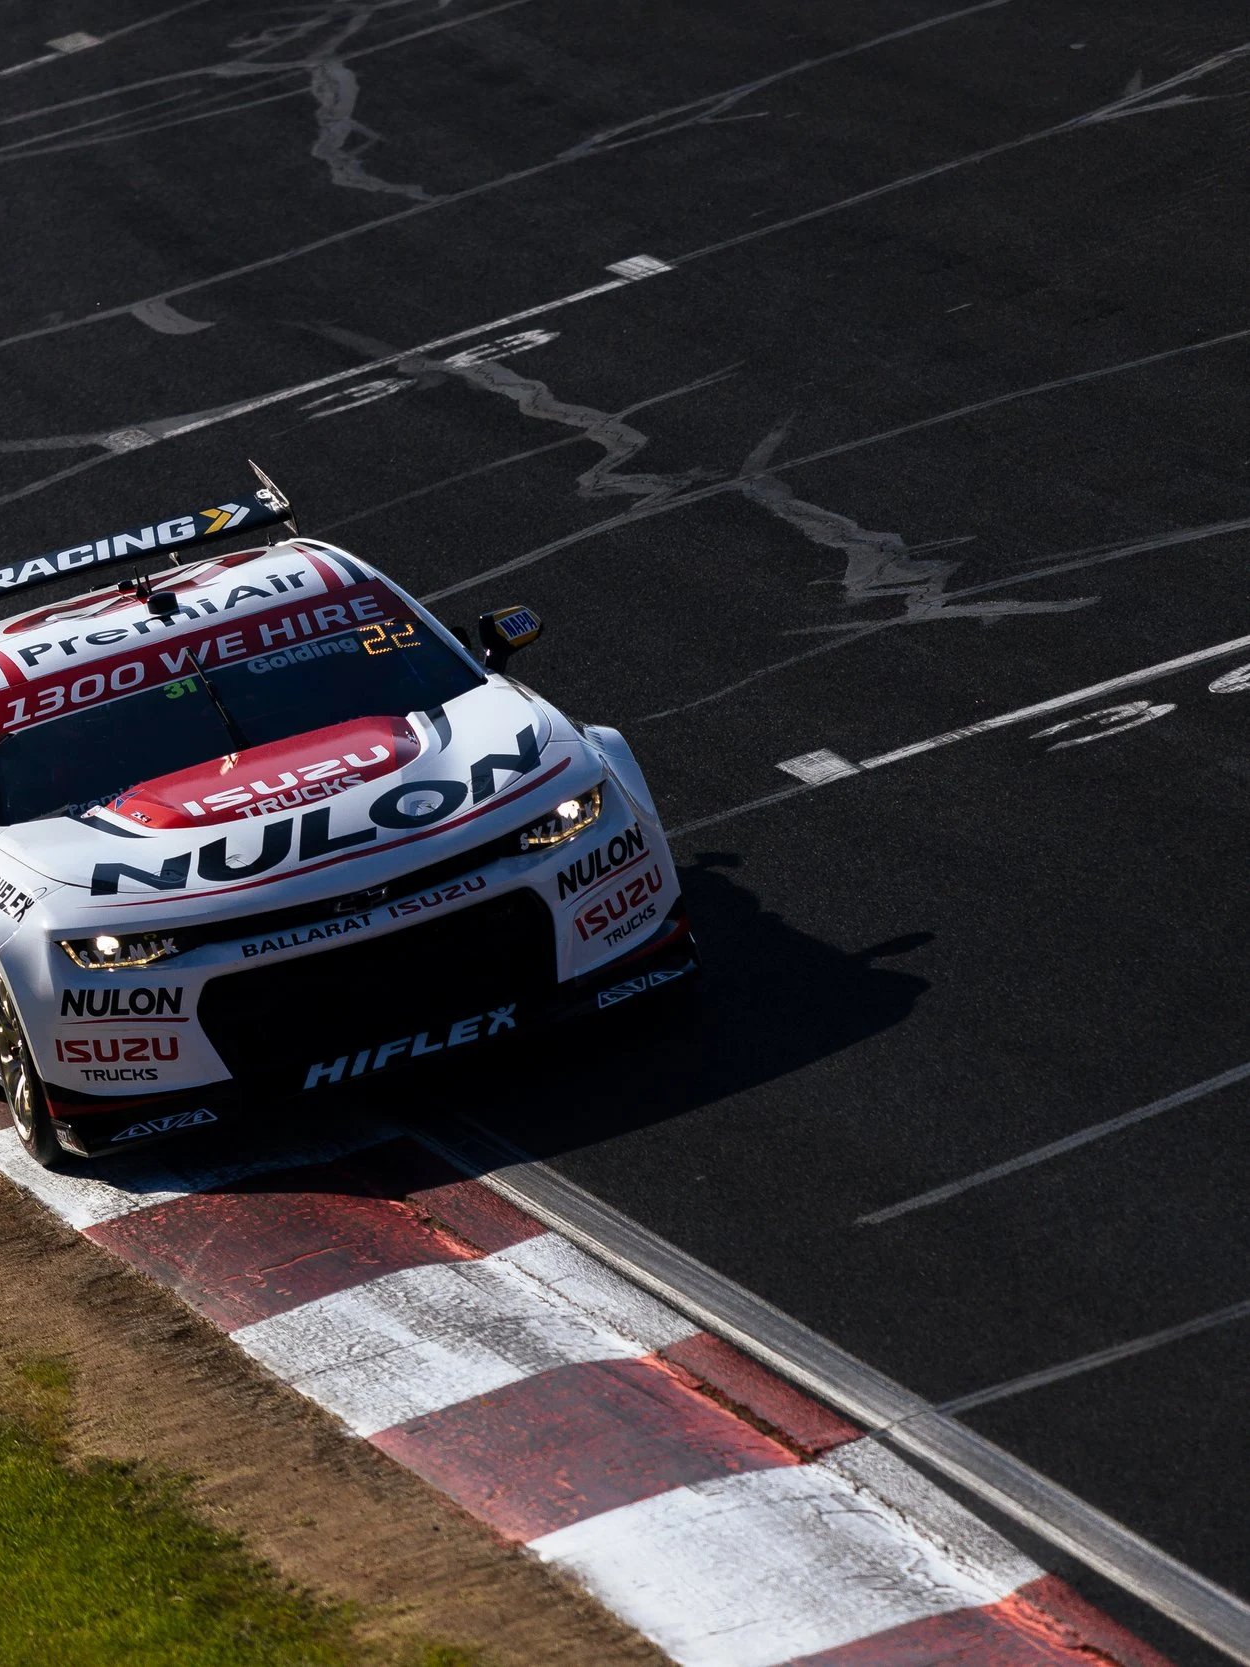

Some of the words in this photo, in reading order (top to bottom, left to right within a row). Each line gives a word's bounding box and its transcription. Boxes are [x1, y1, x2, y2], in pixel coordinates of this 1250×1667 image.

[297, 329, 561, 420] 38
[18, 569, 307, 668] PremiAir
[358, 621, 422, 655] 22
[498, 611, 538, 638] NAPA
[2, 661, 146, 729] 1300
[159, 631, 247, 675] WE
[259, 595, 384, 647] HIRE
[248, 636, 359, 674] Golding
[164, 678, 198, 700] 31
[182, 744, 391, 818] ISUZU
[235, 773, 366, 819] TRUCKS
[91, 724, 542, 897] NULON
[519, 800, 594, 851] SYZMIK
[557, 822, 645, 901] NULON
[241, 913, 372, 958] BALLARAT
[387, 876, 487, 919] ISUZU
[574, 864, 663, 942] ISUZU
[603, 903, 657, 947] TRUCKS
[79, 938, 179, 967] SYZMIK
[61, 987, 183, 1017] NULON
[55, 1037, 179, 1063] ISUZU
[303, 1003, 517, 1090] HIFLEX
[80, 1068, 158, 1081] TRUCKS
